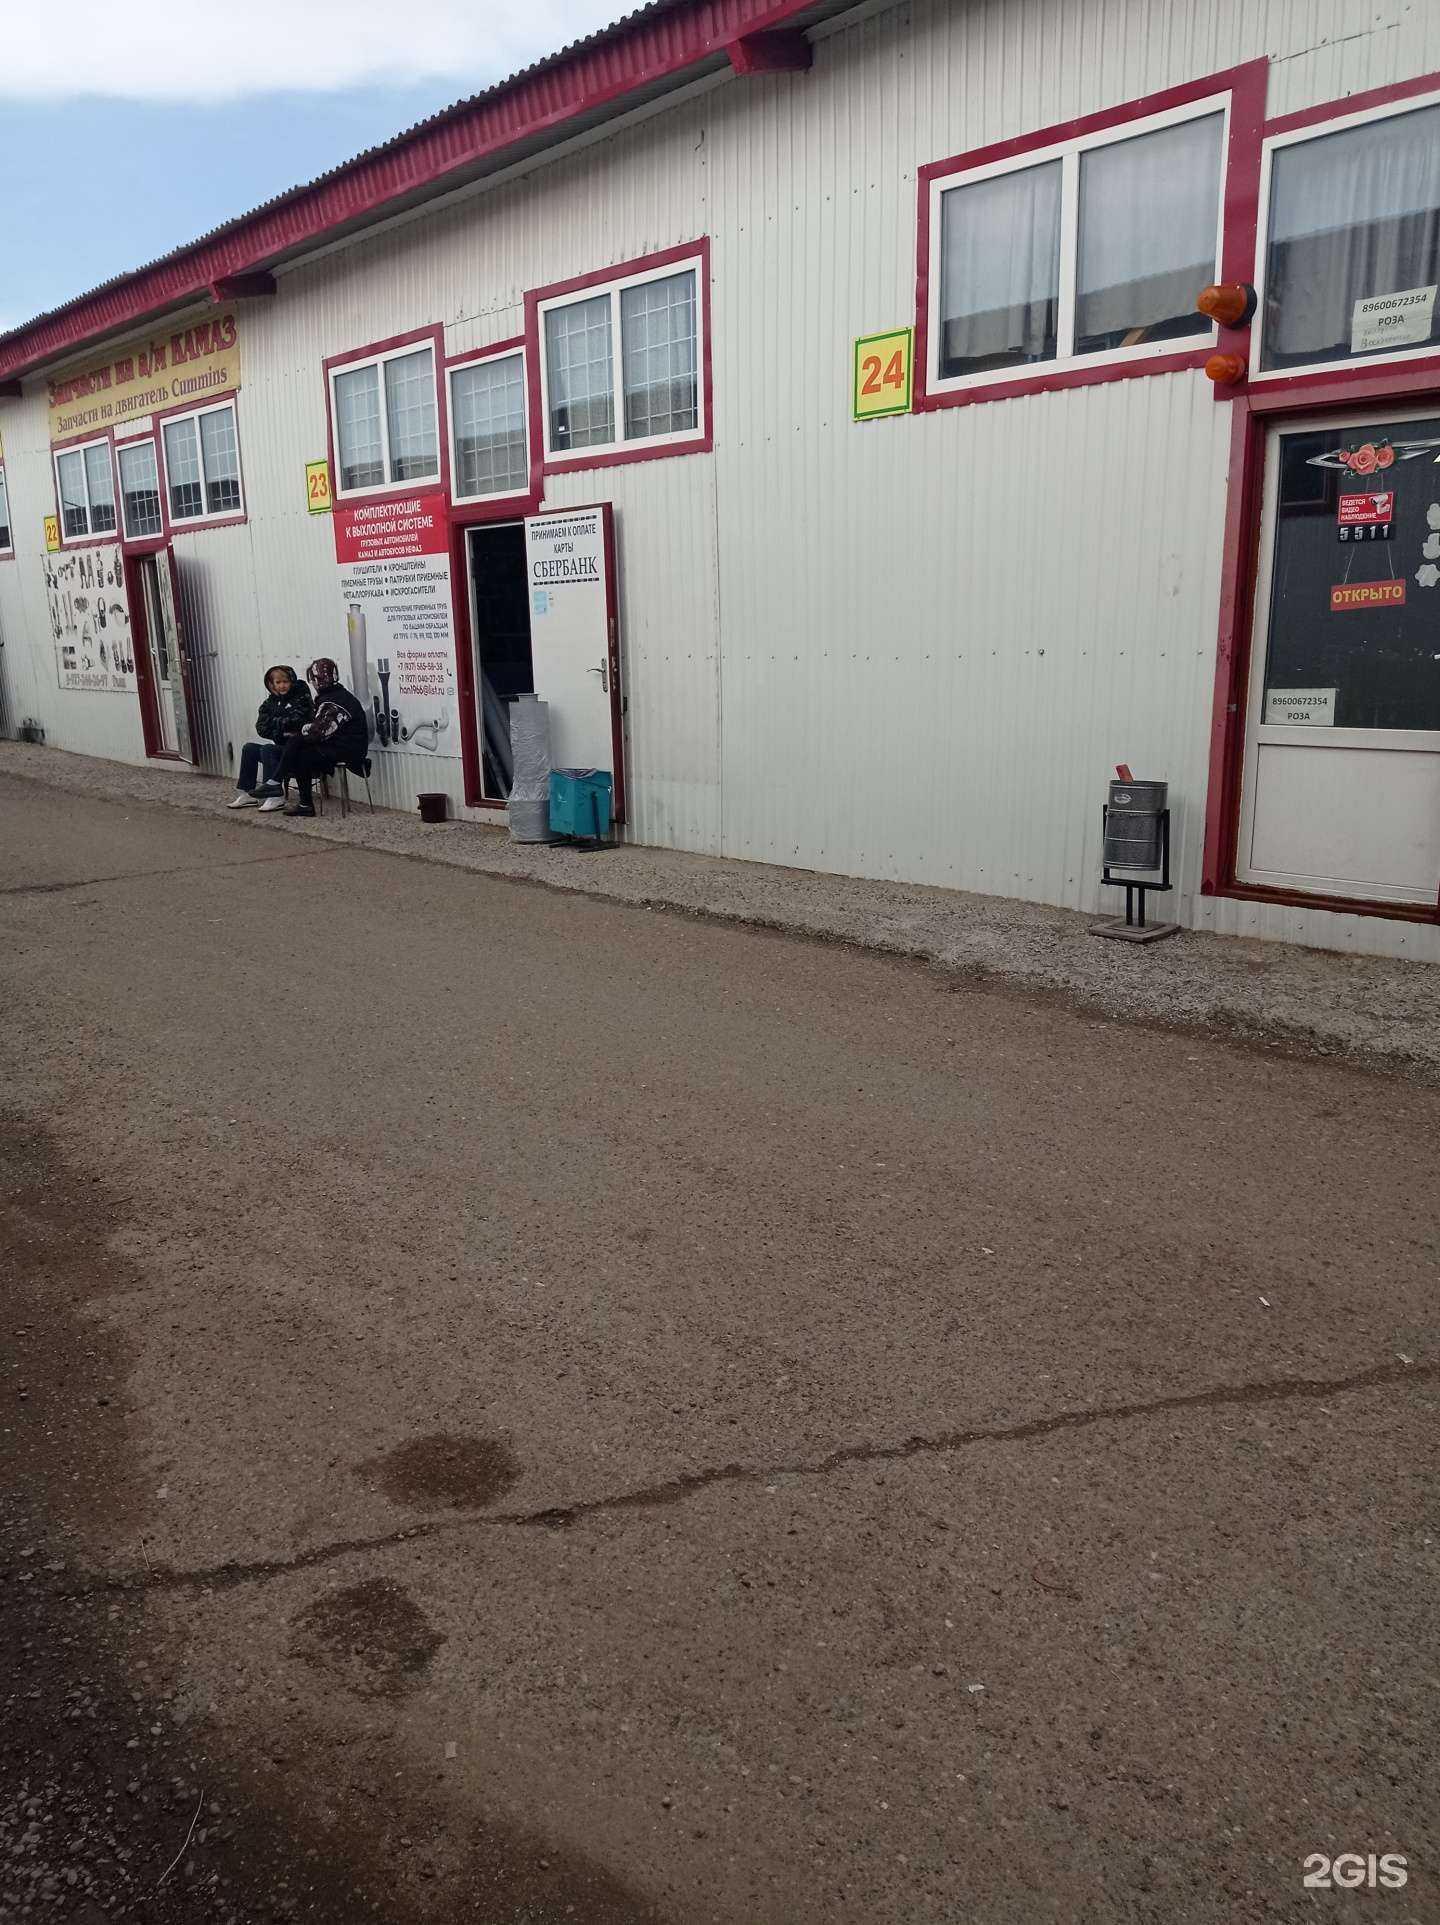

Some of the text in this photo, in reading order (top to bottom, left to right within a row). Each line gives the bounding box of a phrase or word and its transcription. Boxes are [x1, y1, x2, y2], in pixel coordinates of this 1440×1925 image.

[1362, 294, 1427, 313] 89600672354
[1378, 315, 1405, 327] РОЗА
[171, 314, 238, 367] КАМАЗ
[861, 350, 905, 395] 24
[56, 366, 228, 434] Запчасти на двигатель Cummins
[310, 473, 328, 498] 23
[353, 499, 422, 521] КОМПЛЕКТУЮЩИЕ
[47, 525, 58, 542] 22
[345, 516, 434, 539] К ВЫХЛОПНОЙ СИСТЕМЕ
[531, 527, 567, 541] ПРИНИМАЕМ
[572, 523, 596, 537] ОПЛАТЕ
[553, 542, 574, 554] КАРТЫ
[533, 556, 598, 578] СБЕРБАНК
[1332, 586, 1403, 603] ОТКРЫТО
[1272, 697, 1328, 705] 89600672354
[1287, 712, 1311, 720] РОЗА
